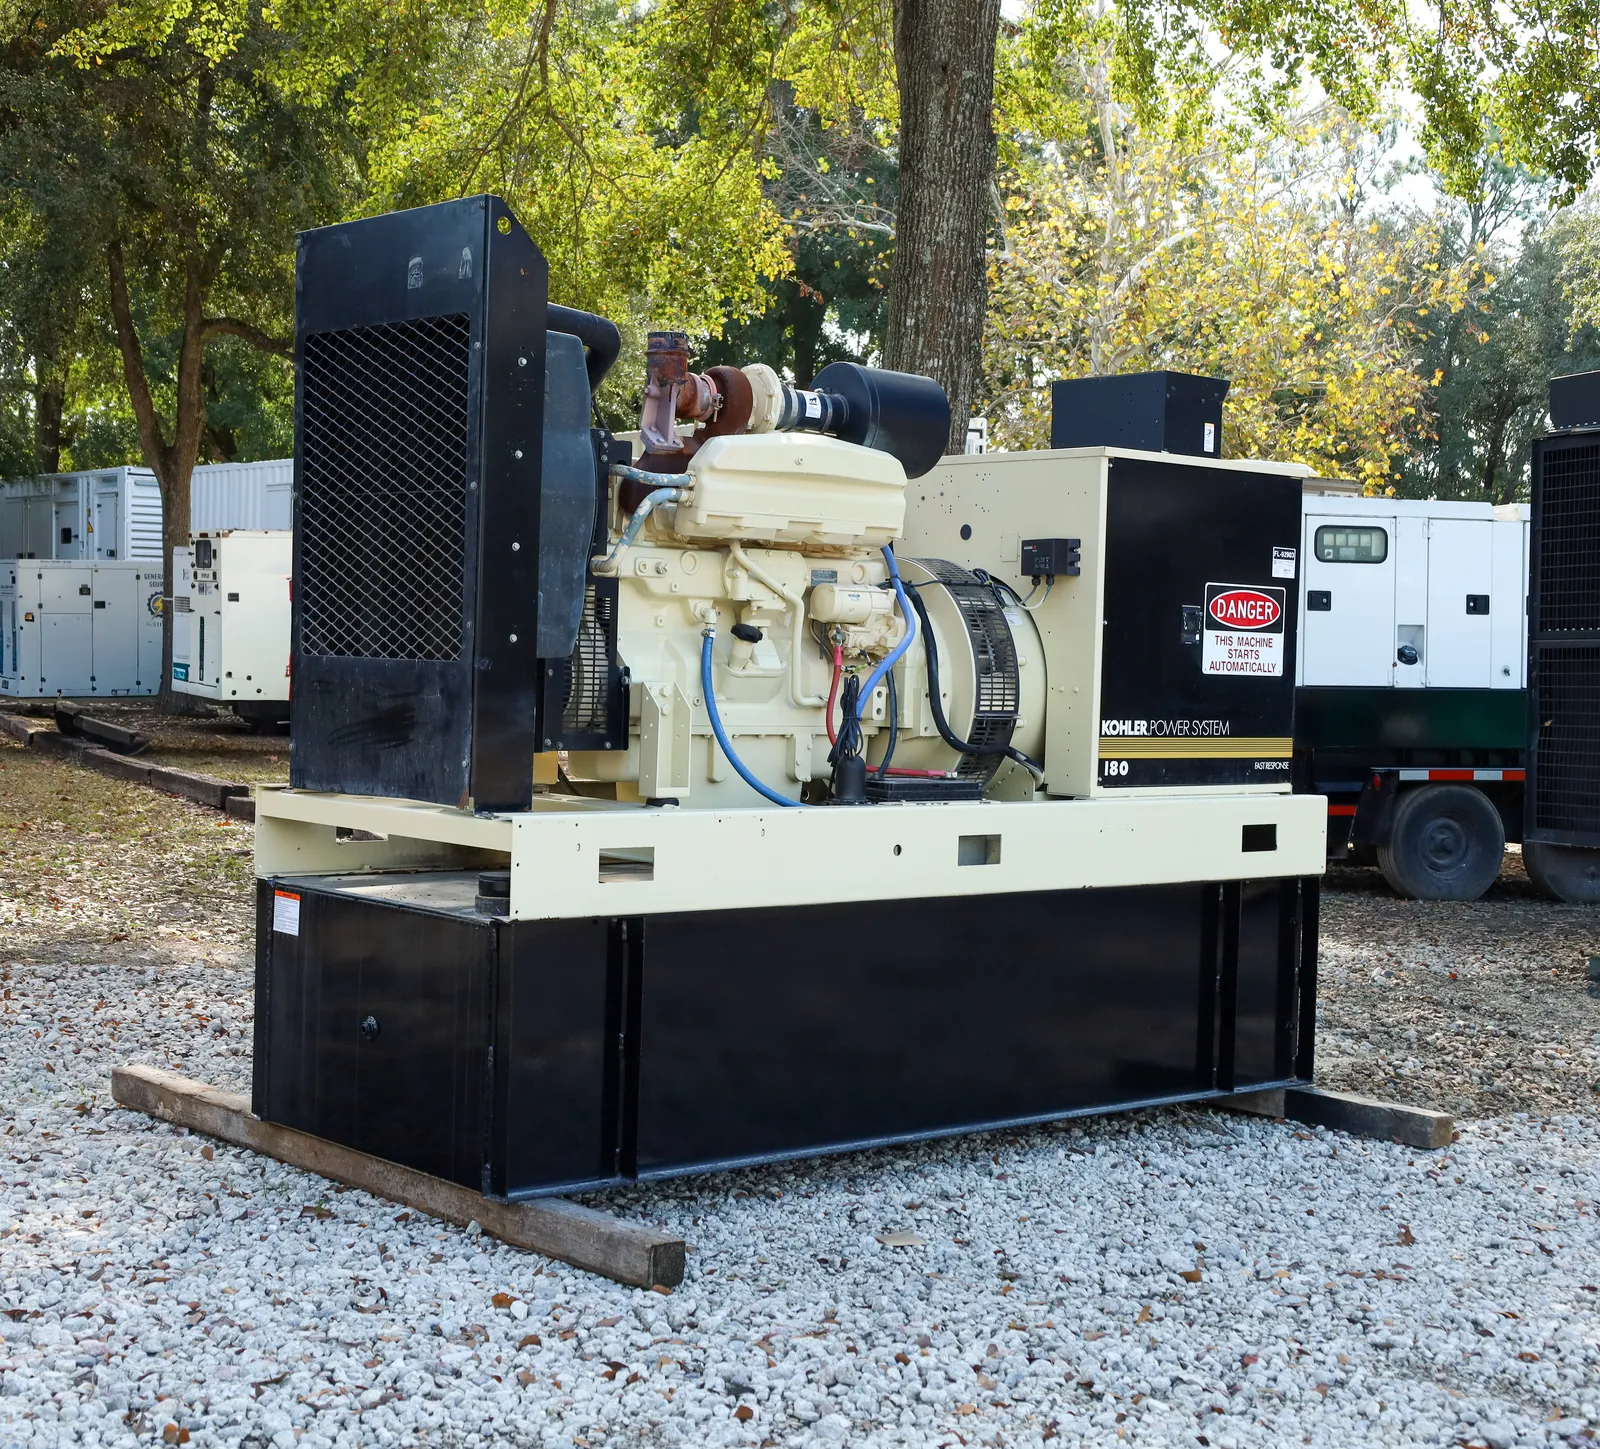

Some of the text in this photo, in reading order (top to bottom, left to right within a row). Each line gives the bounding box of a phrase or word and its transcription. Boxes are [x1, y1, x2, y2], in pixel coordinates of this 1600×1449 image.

[1217, 598, 1274, 620] DANGER
[1215, 635, 1273, 648] THIS MACHINE
[1227, 648, 1260, 660] STARTS
[1209, 660, 1277, 673] AUTOMATICALLY
[1101, 719, 1230, 736] KOHLER POWER SYSTEM
[1104, 760, 1129, 776] 180
[1254, 761, 1290, 770] FAST RESPONSE
